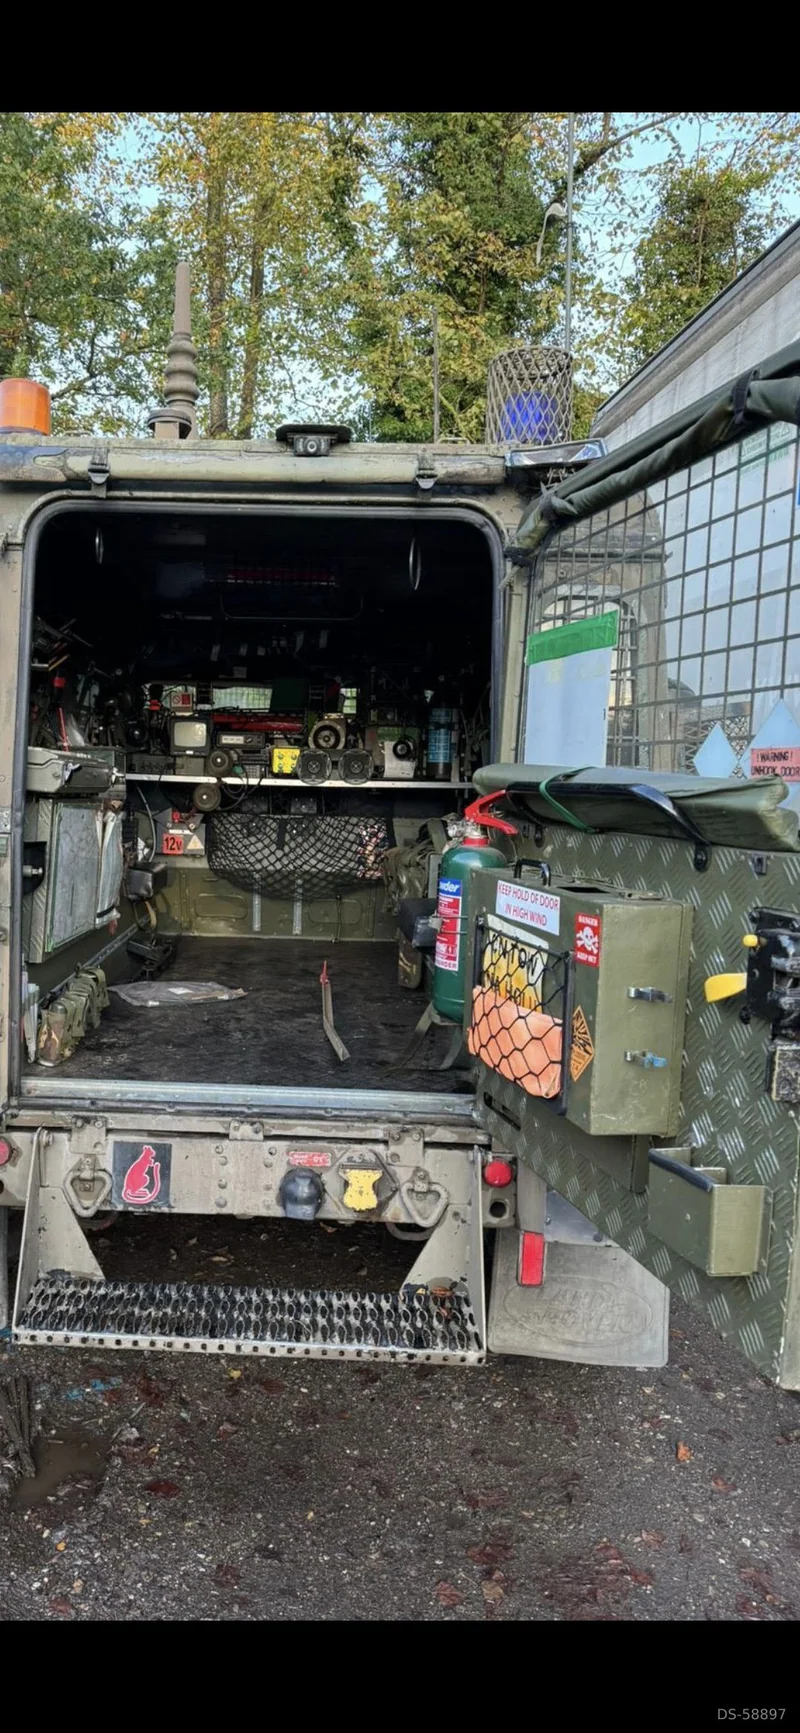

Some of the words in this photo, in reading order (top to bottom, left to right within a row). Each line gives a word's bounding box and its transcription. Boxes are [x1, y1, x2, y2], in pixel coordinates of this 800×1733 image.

[498, 883, 511, 896] KEEP
[512, 887, 529, 901] HOLD
[531, 892, 539, 904] OF
[539, 895, 559, 910] DOOR
[505, 903, 512, 914] IN
[512, 906, 529, 920] HIGH
[529, 911, 547, 926] WIND
[578, 915, 598, 927] DANGER
